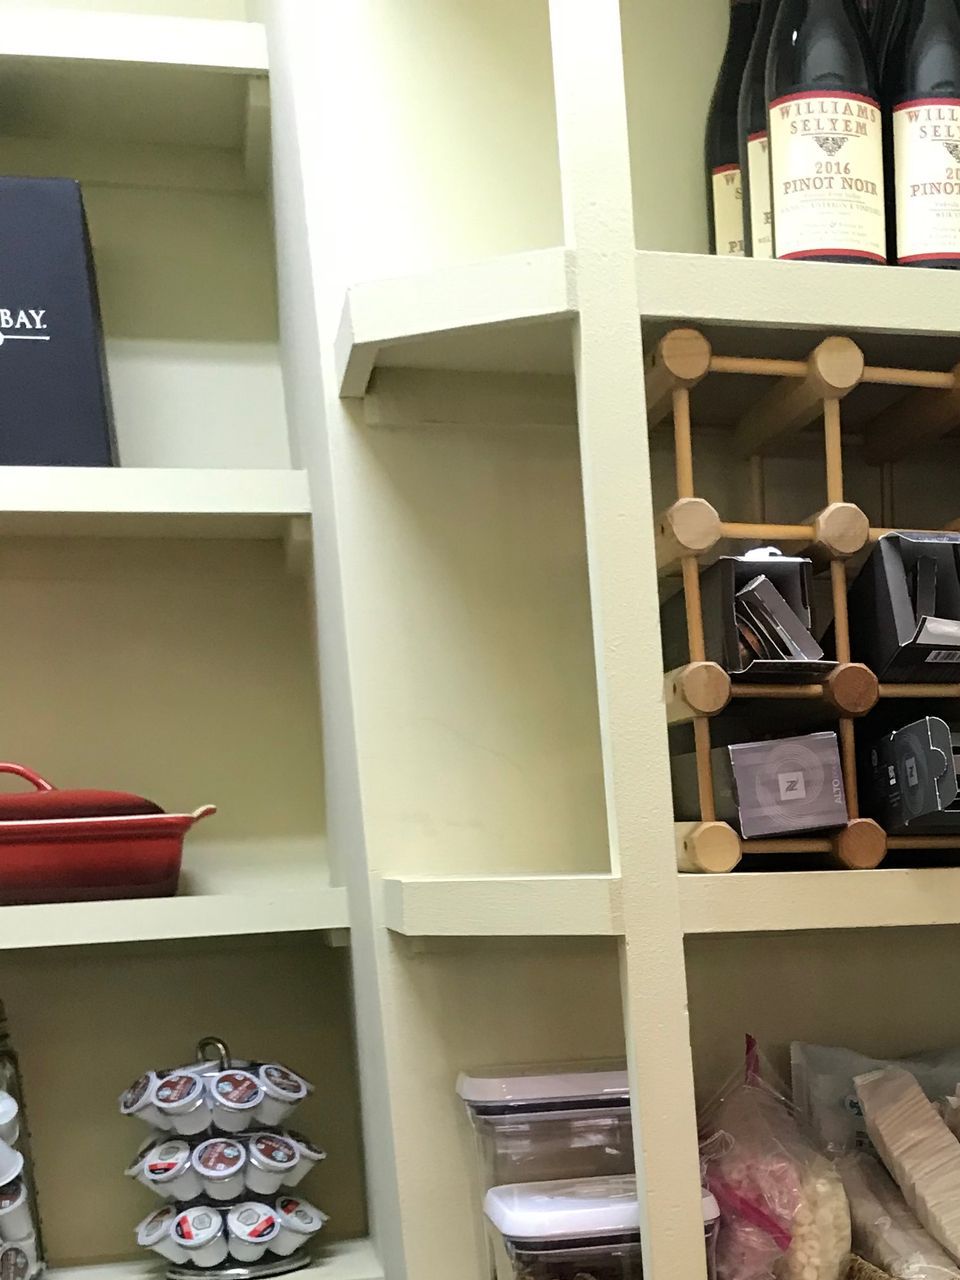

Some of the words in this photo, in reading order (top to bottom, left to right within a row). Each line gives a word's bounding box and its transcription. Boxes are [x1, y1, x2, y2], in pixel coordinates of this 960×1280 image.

[779, 101, 877, 123] WILLIAMS
[790, 118, 868, 136] SELYEM
[816, 161, 851, 175] 2016
[783, 176, 834, 195] PINOT
[841, 177, 878, 196] NOIR
